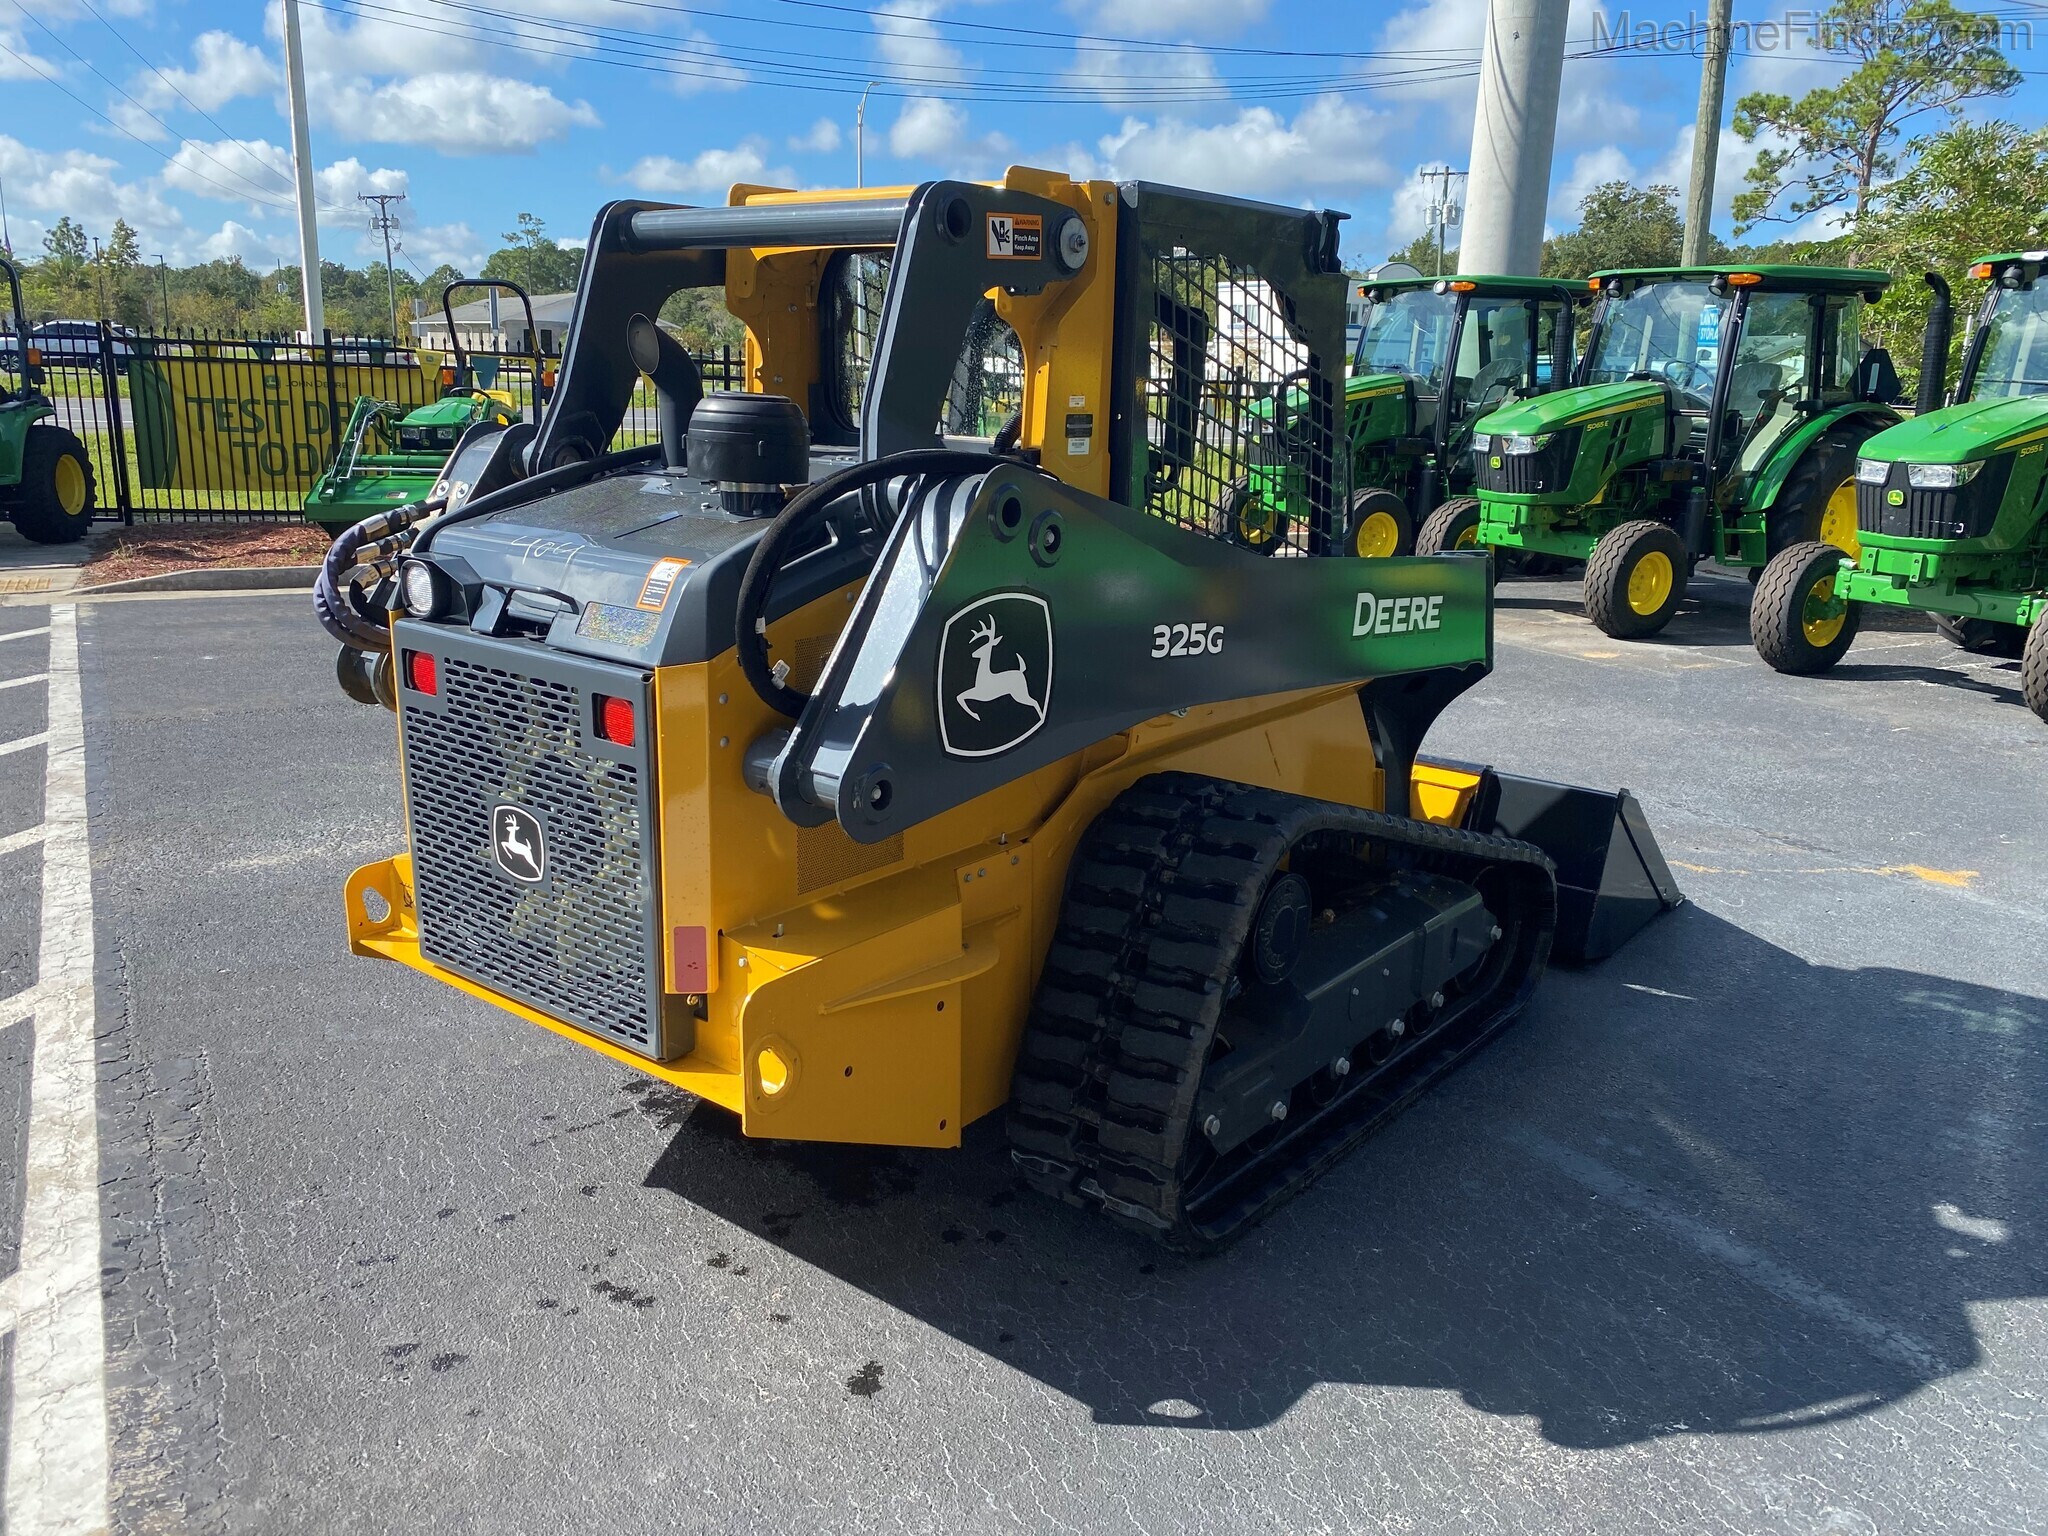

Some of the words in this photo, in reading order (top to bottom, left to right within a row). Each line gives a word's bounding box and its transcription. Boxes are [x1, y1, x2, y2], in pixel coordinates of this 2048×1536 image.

[315, 380, 347, 389] DERE
[185, 396, 289, 434] TEST
[1352, 592, 1444, 637] DEERE
[1151, 622, 1225, 658] 325G
